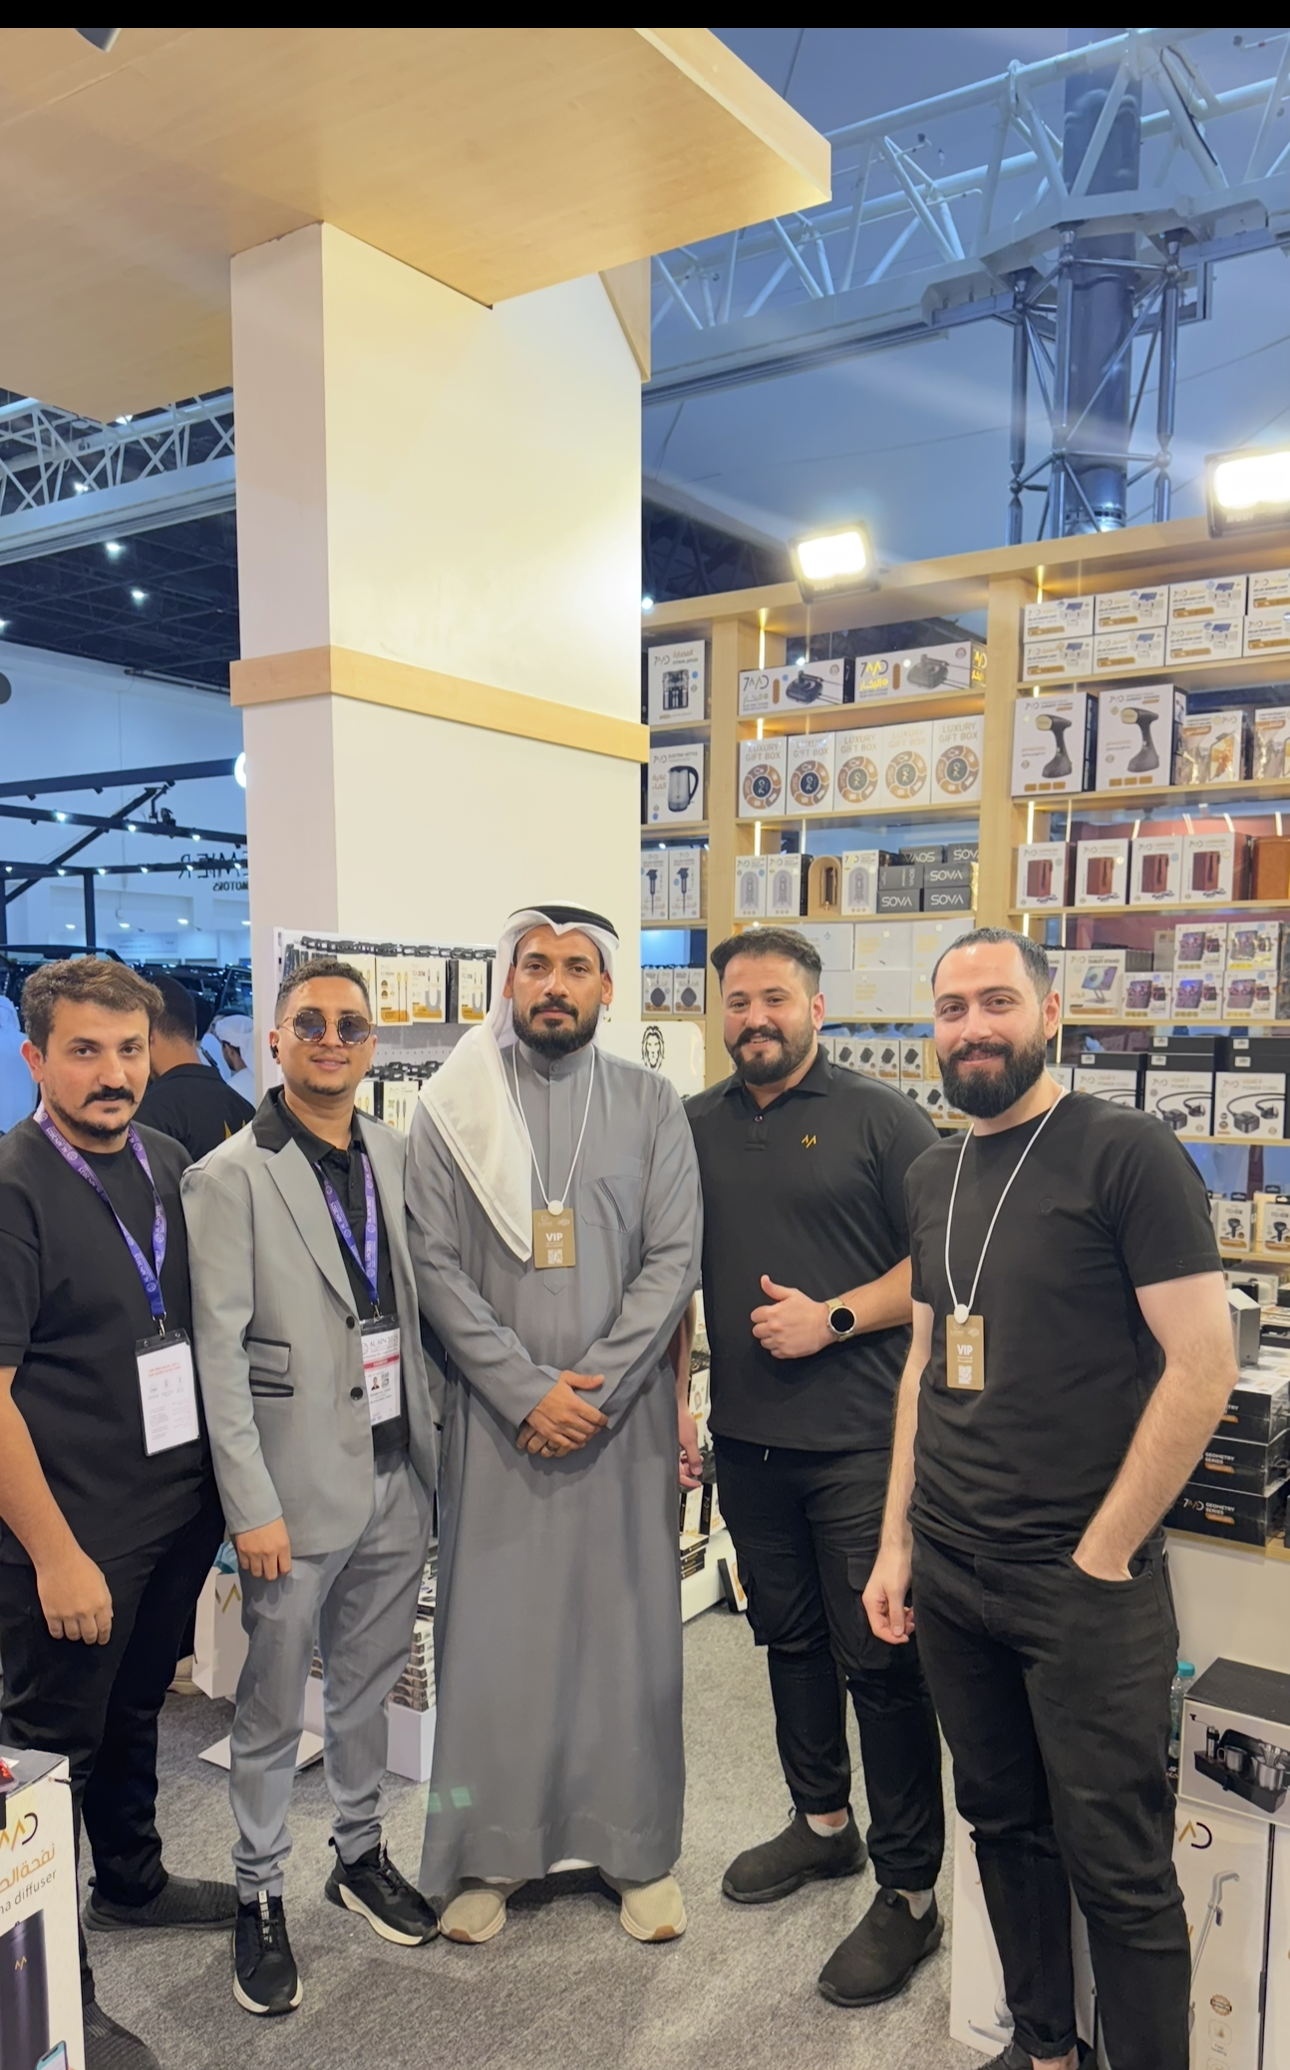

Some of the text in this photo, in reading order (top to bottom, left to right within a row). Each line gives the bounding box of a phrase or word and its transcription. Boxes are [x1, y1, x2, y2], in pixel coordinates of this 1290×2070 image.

[960, 731, 978, 740] BOX
[861, 743, 877, 752] BOX
[930, 870, 963, 881] SOVA
[882, 896, 912, 907] SOVA
[931, 894, 964, 905] SOVA
[546, 1232, 563, 1242] VIP
[957, 1344, 973, 1355] VIP
[1205, 1452, 1235, 1461] GEOMETRY
[1205, 1502, 1235, 1512] GEOMETRY
[14, 1869, 57, 1906] diffuser
